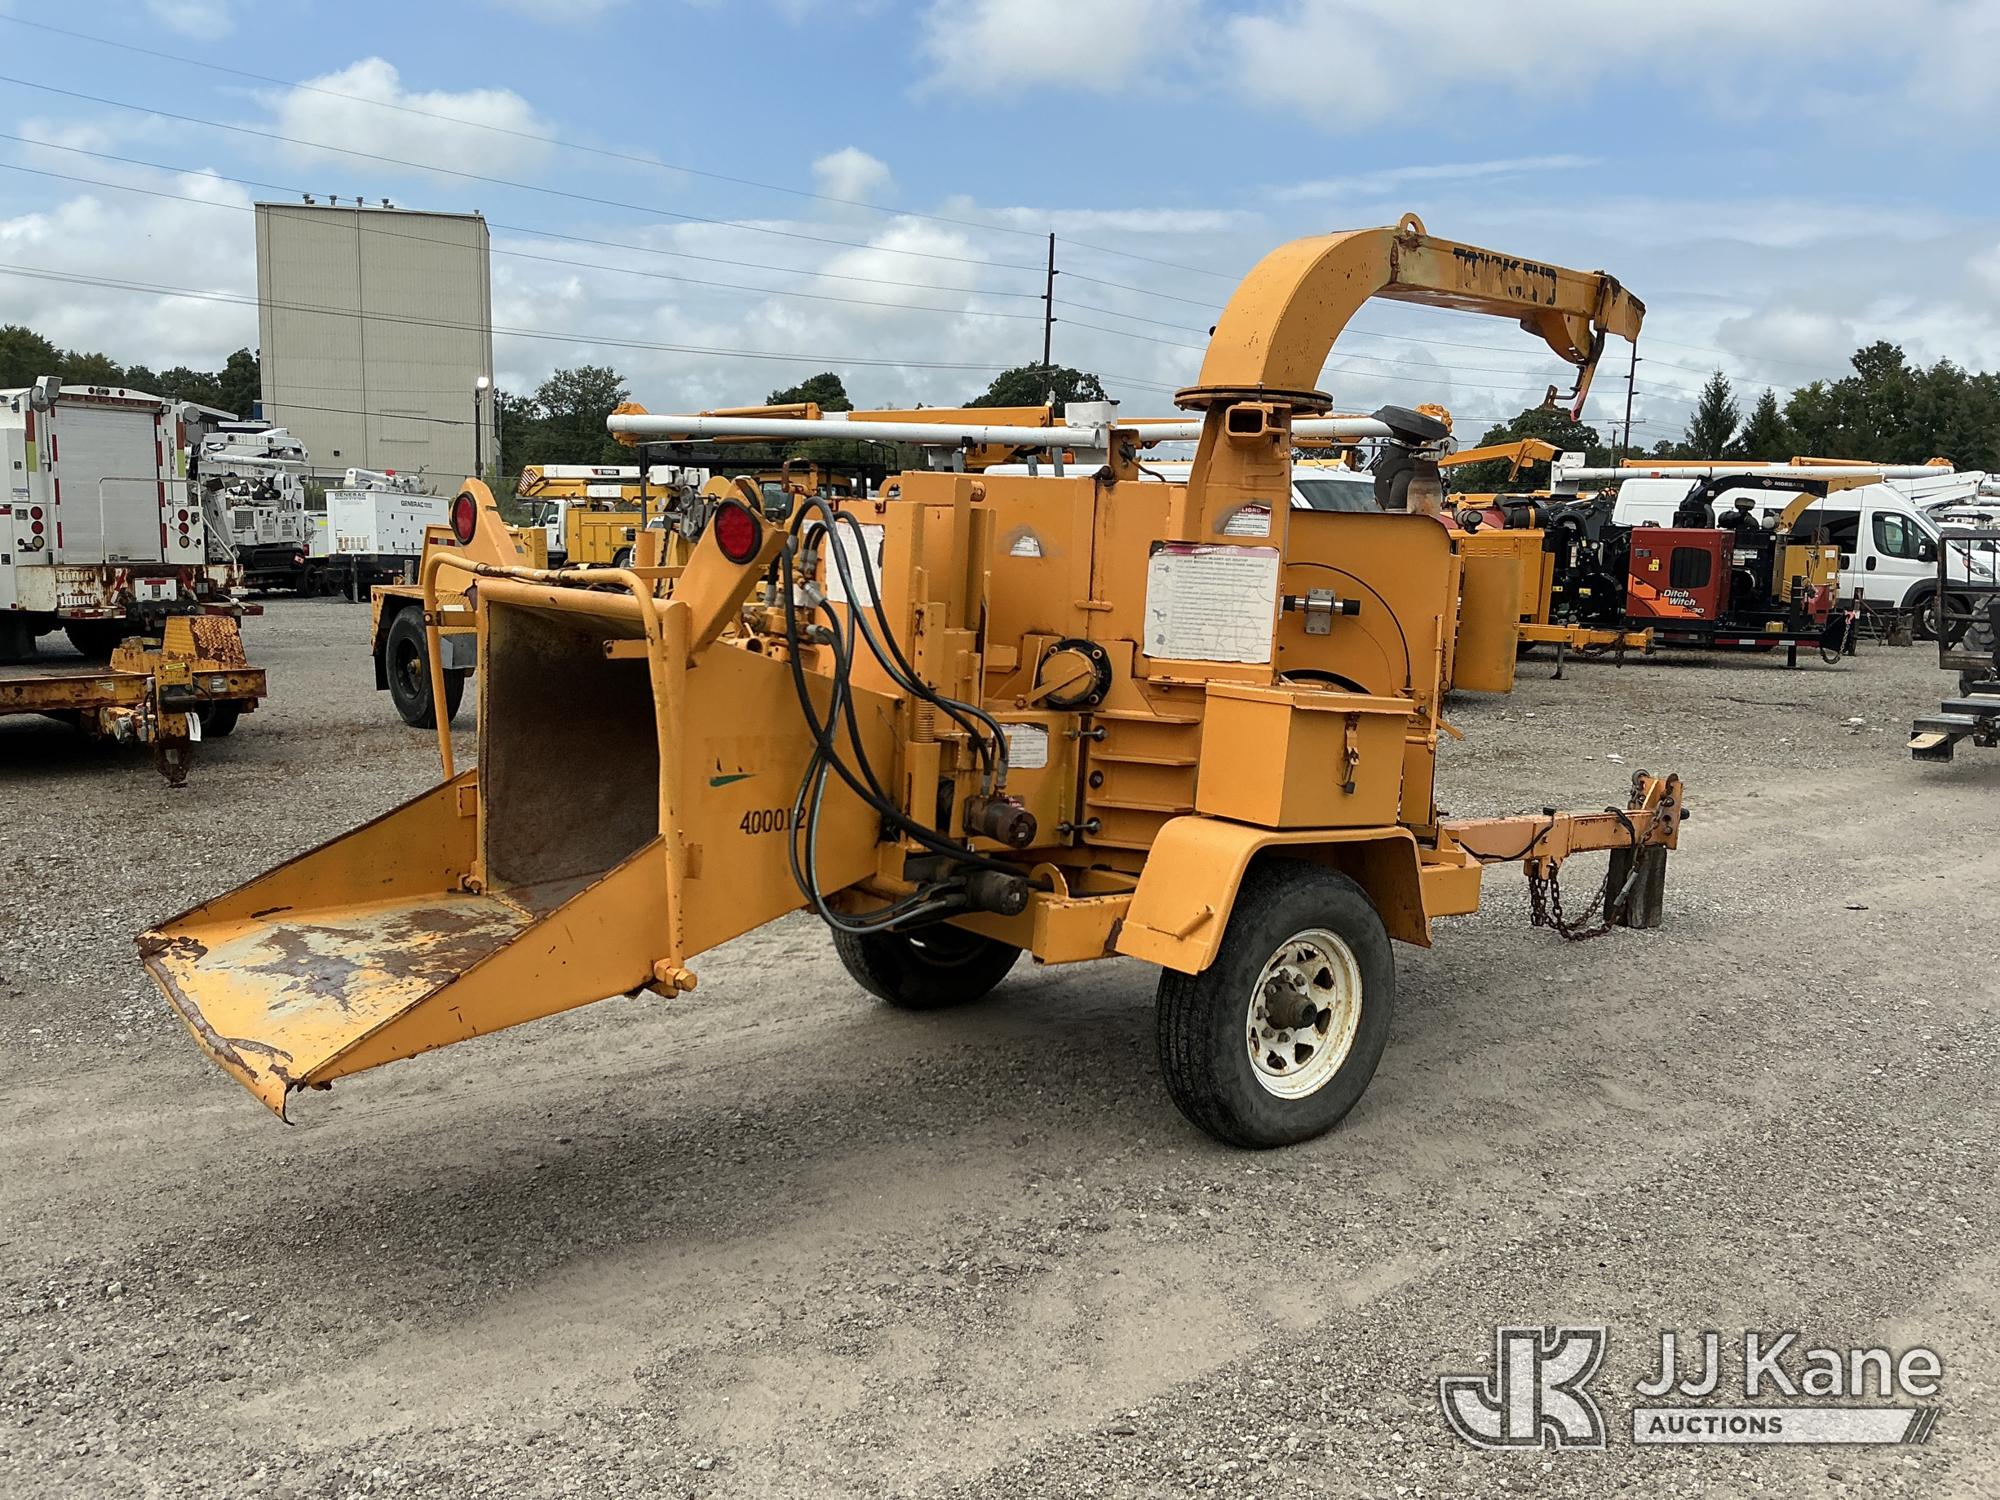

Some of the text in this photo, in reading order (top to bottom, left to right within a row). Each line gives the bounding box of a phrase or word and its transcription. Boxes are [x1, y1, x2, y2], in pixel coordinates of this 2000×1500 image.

[400, 500, 424, 508] GENERAC
[1663, 589, 1689, 597] Ditch
[1669, 598, 1696, 606] Witch
[739, 808, 806, 835] 400012
